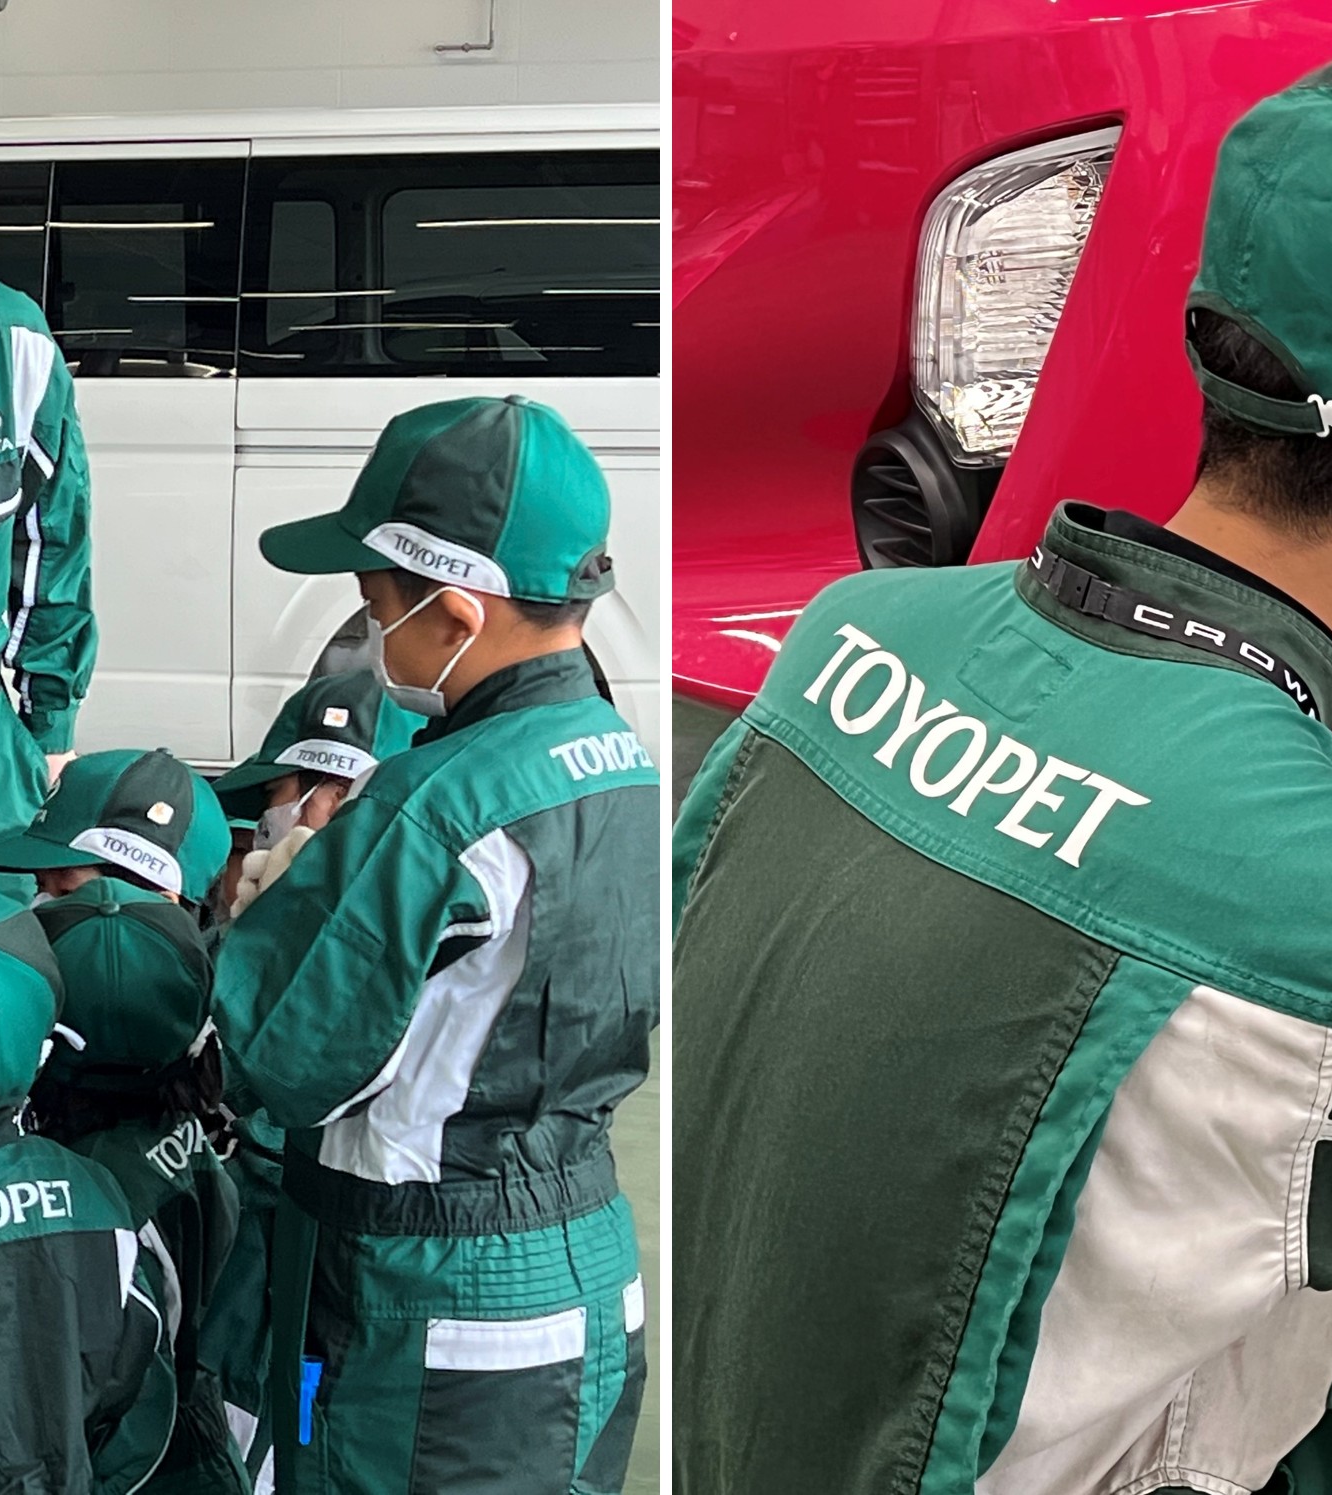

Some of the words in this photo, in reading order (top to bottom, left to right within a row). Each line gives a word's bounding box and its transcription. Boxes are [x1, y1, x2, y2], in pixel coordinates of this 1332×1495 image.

[393, 533, 476, 578] TOYOPET
[1133, 604, 1316, 720] CROW
[296, 750, 358, 771] TOYOPET
[804, 623, 1152, 869] TOYOPET
[103, 834, 168, 875] TOYOPET
